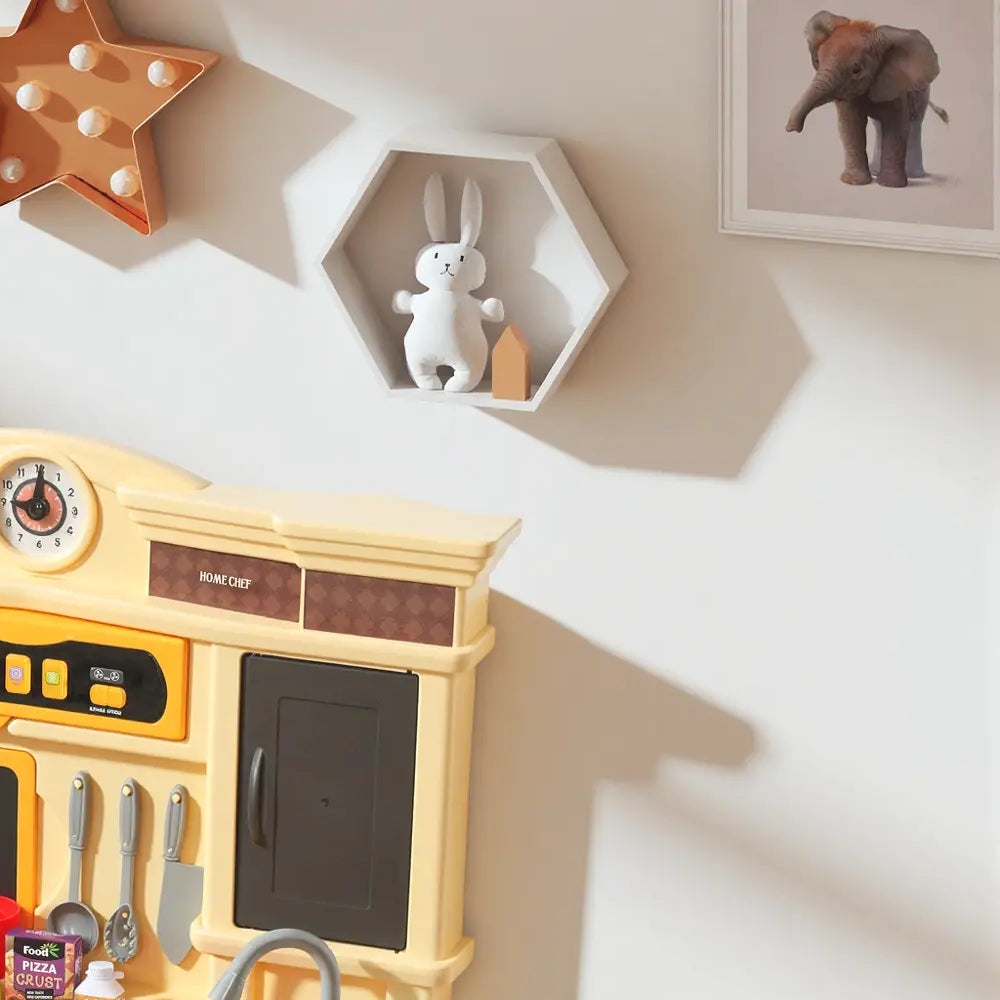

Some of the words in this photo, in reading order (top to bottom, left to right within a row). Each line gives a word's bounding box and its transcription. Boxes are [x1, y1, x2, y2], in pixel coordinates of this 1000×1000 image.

[17, 468, 25, 477] 11
[2, 480, 13, 490] 10
[68, 488, 75, 497] 2
[0, 498, 7, 506] 9
[5, 518, 12, 527] 8
[36, 540, 42, 548] 6
[54, 538, 61, 547] 5
[199, 571, 227, 585] HOME
[228, 576, 252, 589] CHEF
[23, 945, 49, 957] Food
[22, 960, 57, 974] PIZZA
[16, 973, 63, 990] CRUST
